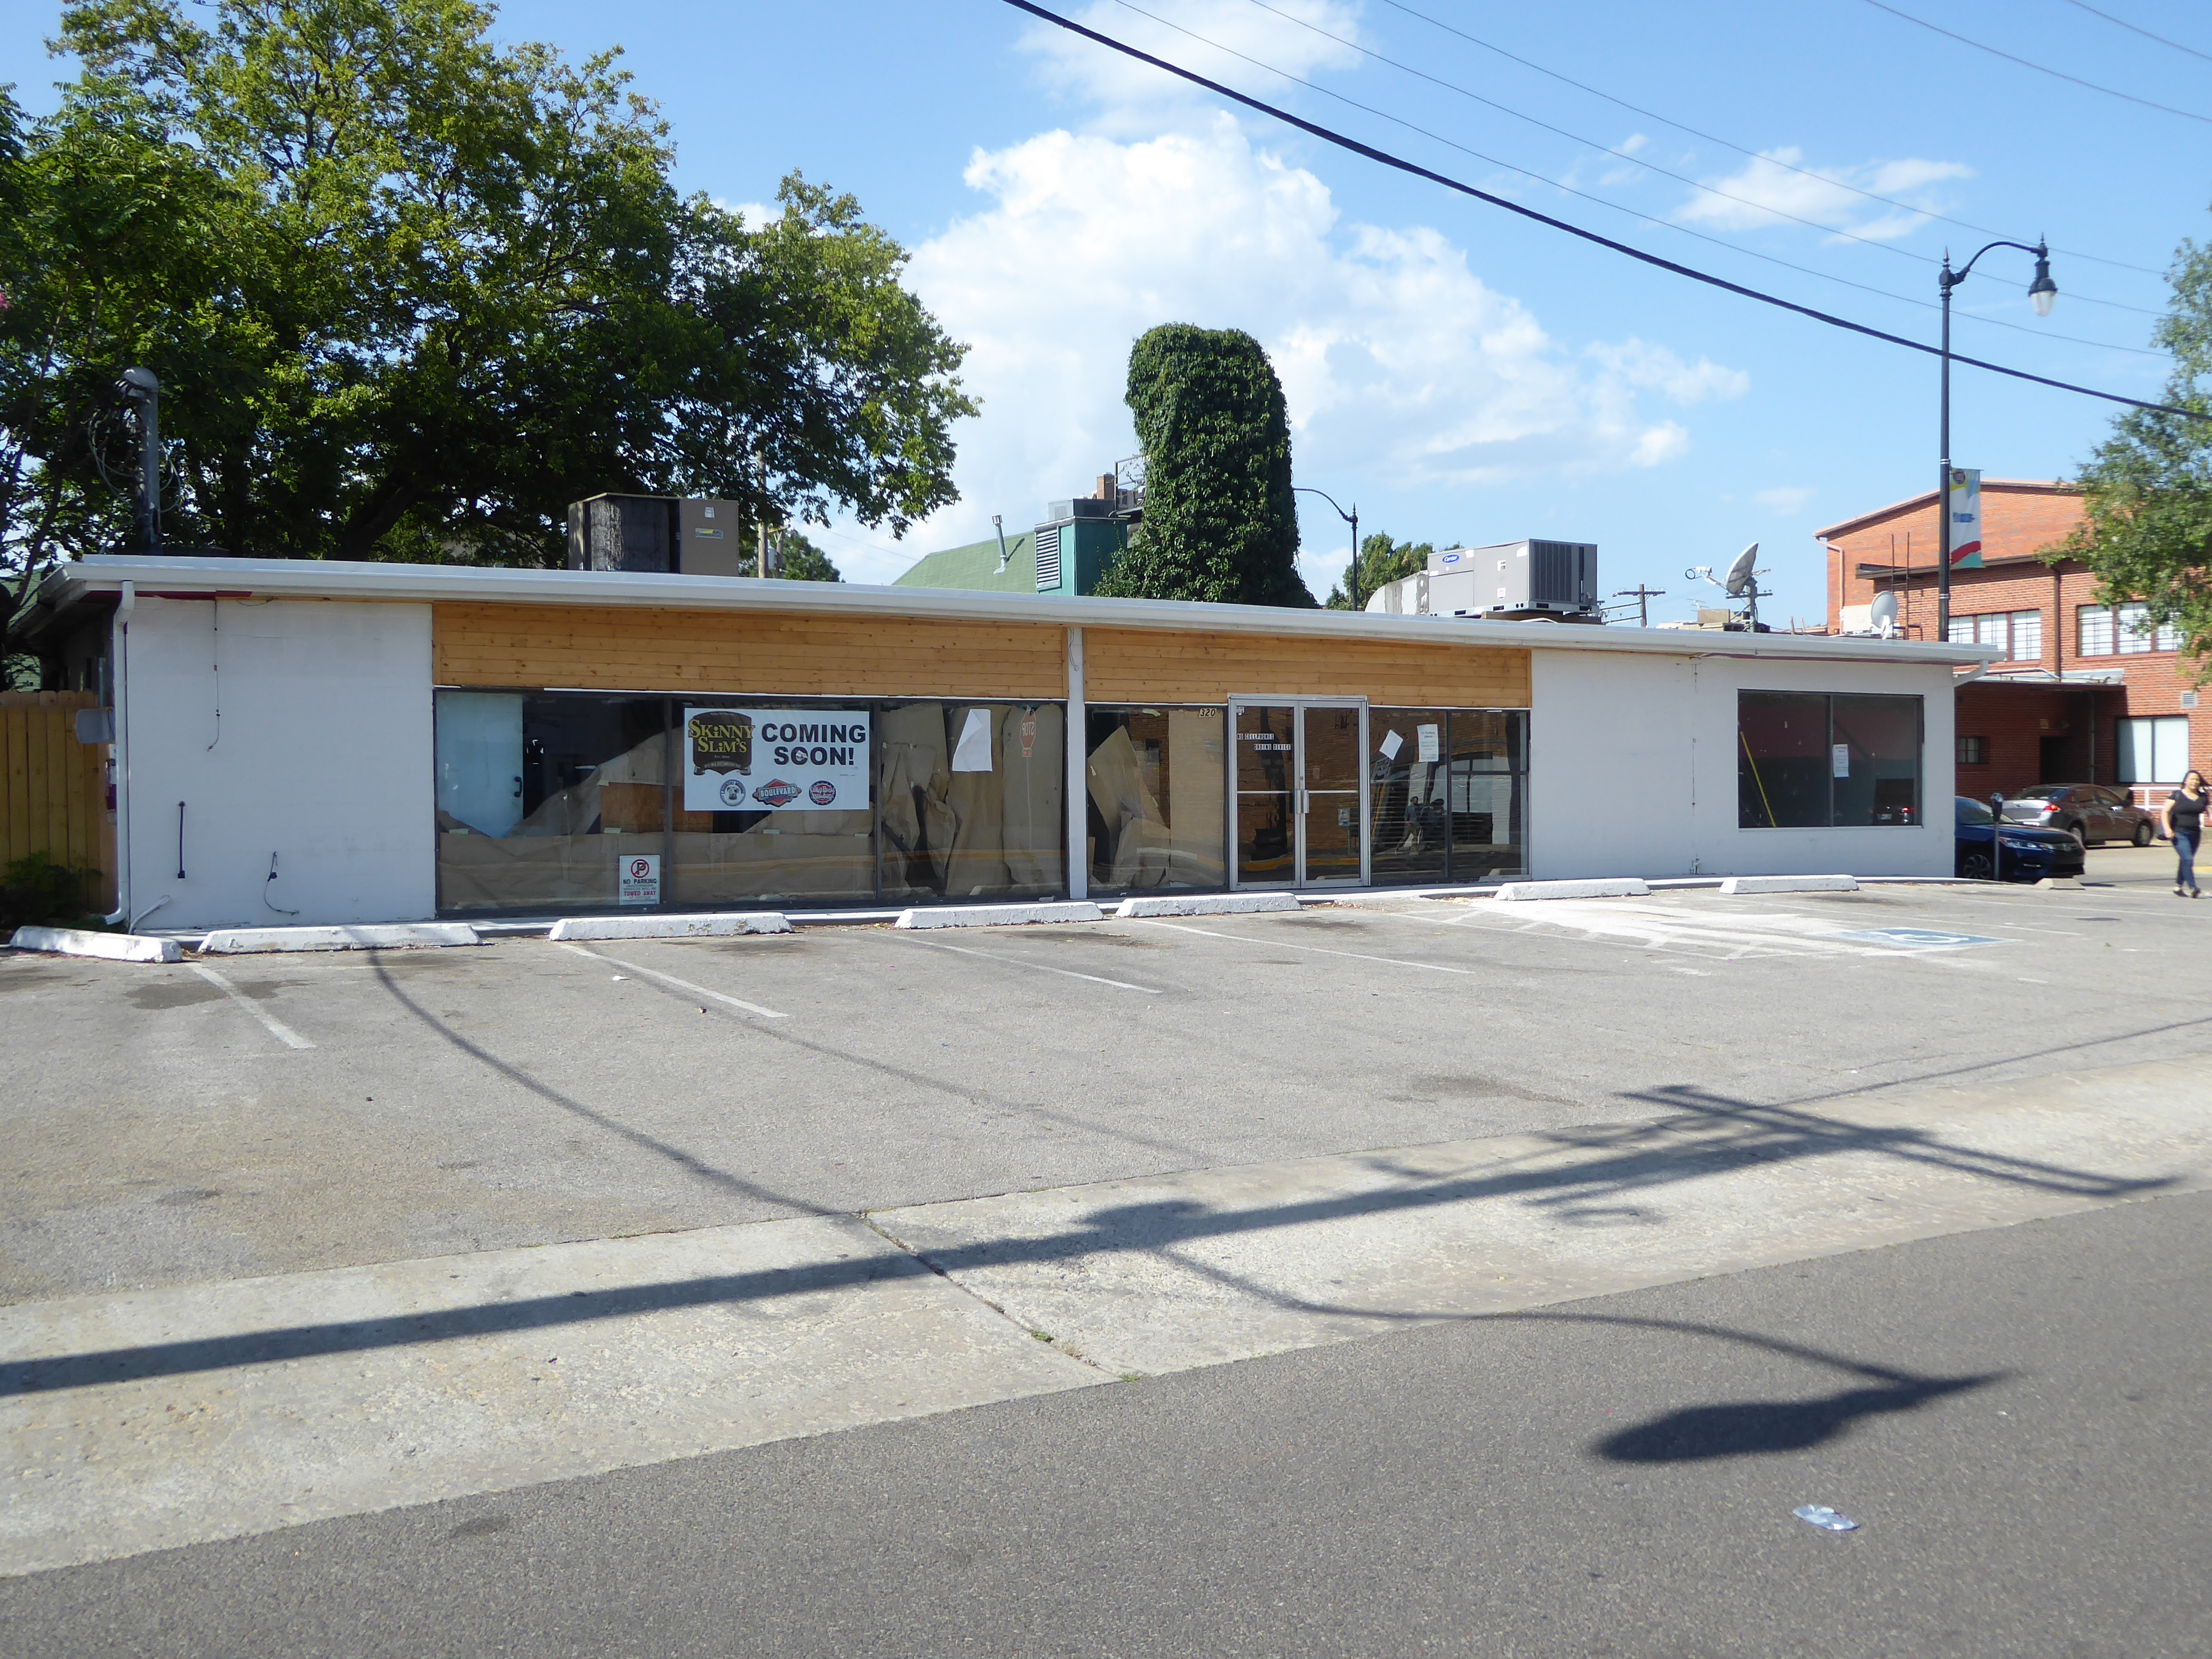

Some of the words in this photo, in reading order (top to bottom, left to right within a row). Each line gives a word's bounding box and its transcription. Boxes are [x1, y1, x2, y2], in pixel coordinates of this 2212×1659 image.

[1200, 708, 1215, 717] 320
[761, 723, 866, 743] COMING
[774, 746, 854, 766] SOON!
[760, 786, 796, 797] BOULEVARD
